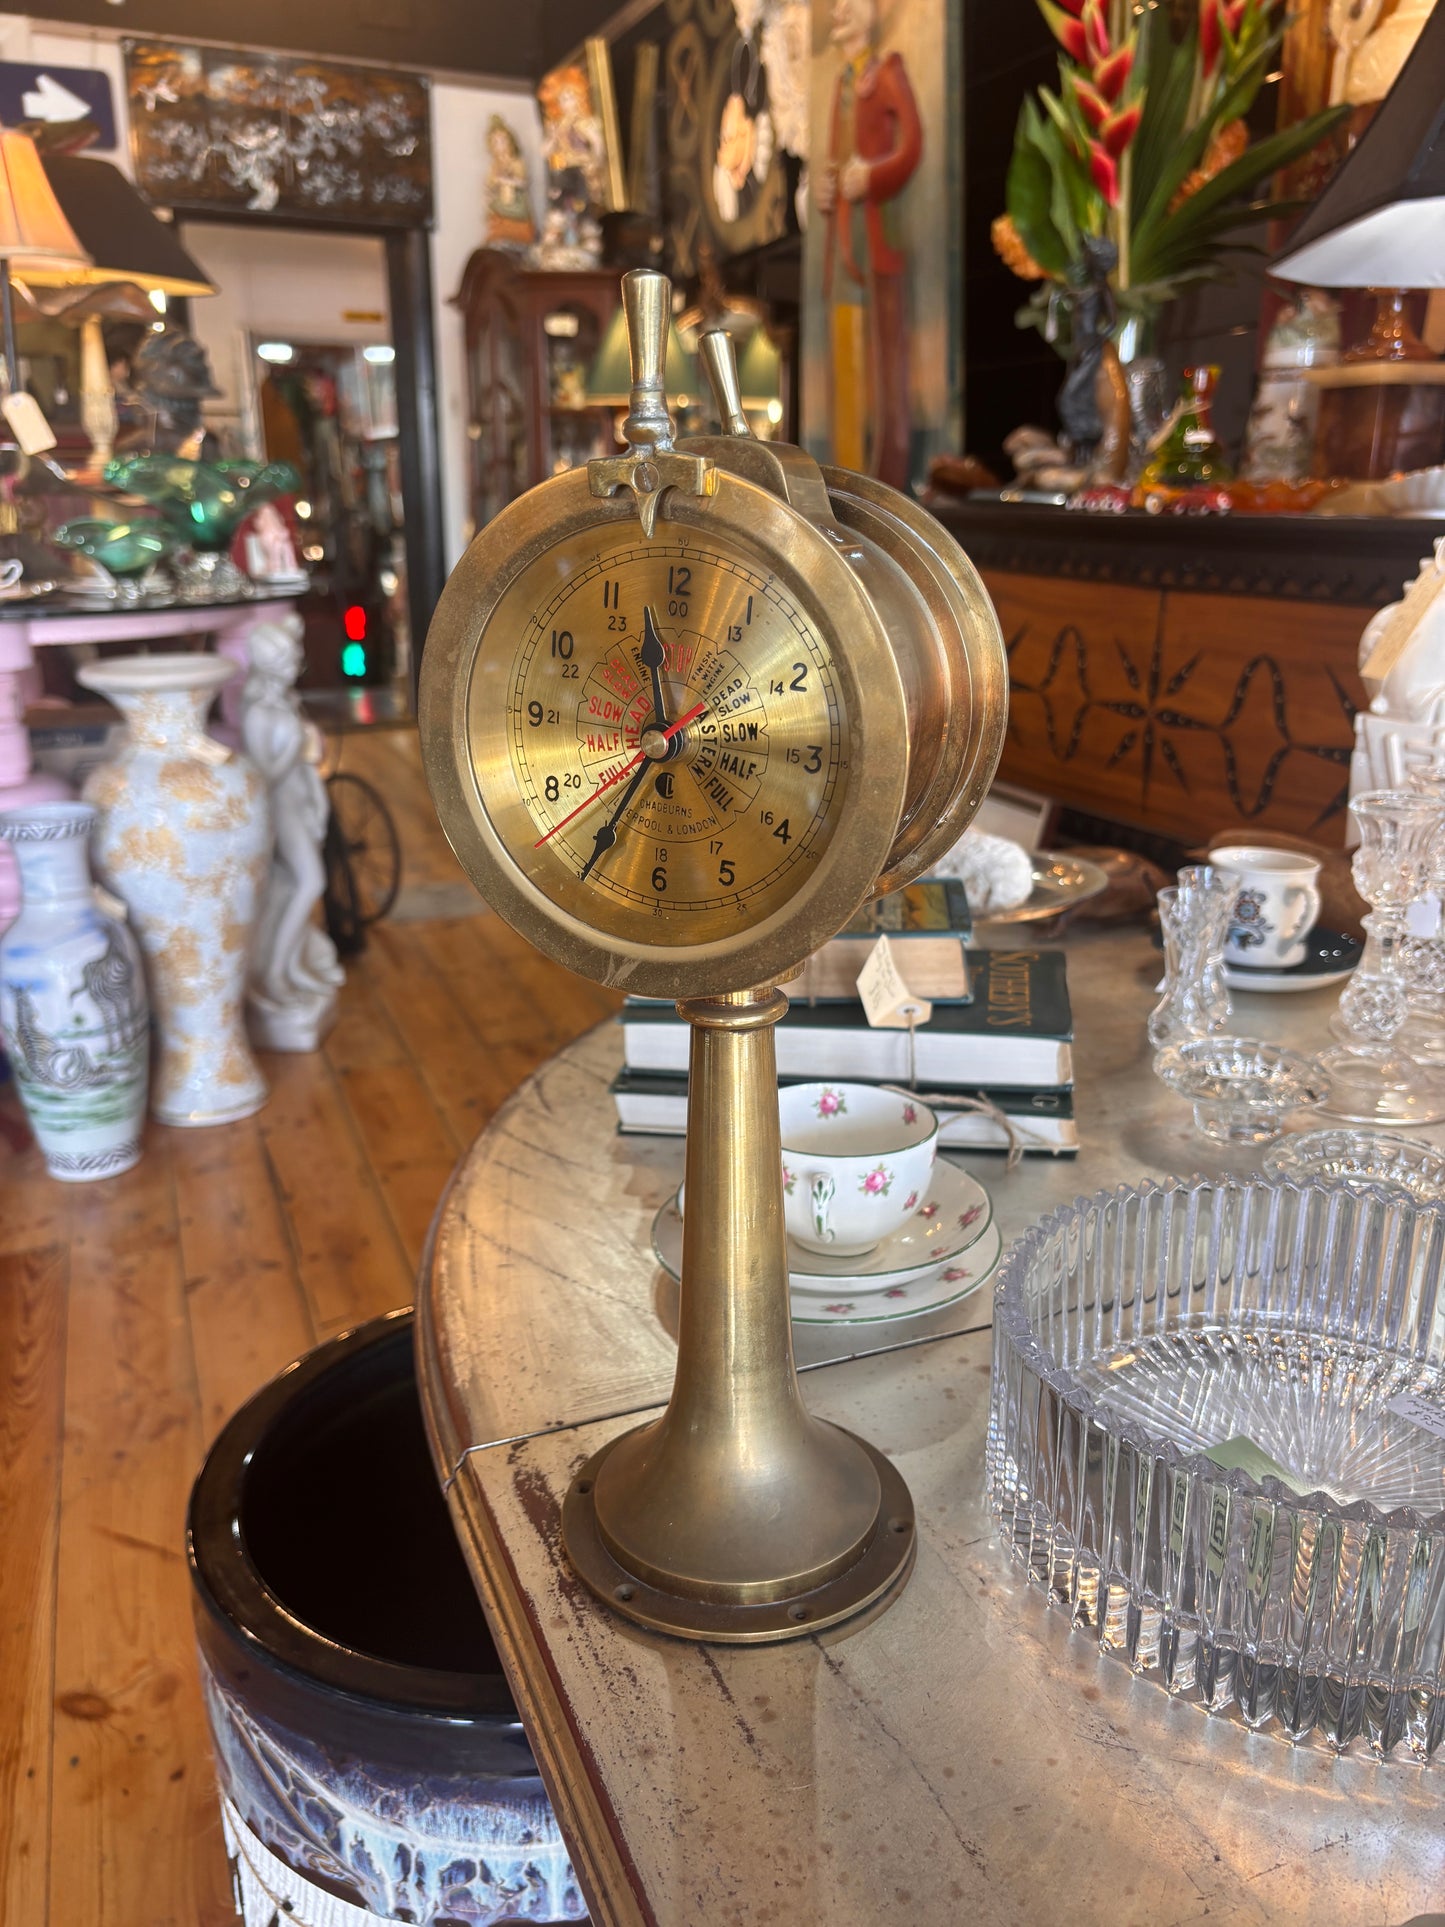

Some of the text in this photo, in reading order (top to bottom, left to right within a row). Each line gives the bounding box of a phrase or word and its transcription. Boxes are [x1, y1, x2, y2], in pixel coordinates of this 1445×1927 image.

[668, 566, 691, 596] 12
[604, 580, 619, 609] 11
[668, 600, 688, 617] 00
[746, 595, 753, 625] 1
[608, 616, 626, 631] 23
[728, 625, 742, 641] 13
[552, 630, 573, 660] 10
[663, 643, 692, 673] STOP
[562, 664, 579, 679] 22
[610, 659, 638, 692] DEAD
[691, 651, 712, 681] FINISH
[701, 658, 718, 681] WITH
[703, 663, 725, 695] ENGINE
[790, 662, 807, 692] 2
[602, 669, 630, 699] SLOW
[712, 678, 742, 706] DEAD
[770, 680, 784, 696] 14
[528, 701, 543, 727] 9
[547, 710, 560, 724] 21
[588, 695, 624, 723] SLOW
[718, 692, 751, 717] SLOW
[586, 732, 619, 753] HALF
[693, 711, 718, 779] ASTERN
[722, 722, 758, 743] SLOW
[720, 752, 757, 780] HALF
[786, 748, 800, 764] 15
[803, 745, 822, 774] 3
[564, 773, 581, 789] 20
[598, 761, 631, 786] FULL
[545, 775, 560, 802] 8
[704, 777, 734, 812] FULL
[613, 796, 662, 833] LERPOOL
[667, 825, 673, 834] &
[677, 816, 717, 835] LONDON
[640, 799, 693, 819] CHADBURNS
[760, 810, 774, 826] 16
[772, 818, 792, 845] 4
[655, 847, 668, 862] 18
[710, 840, 723, 855] 17
[652, 866, 667, 892] 6
[718, 859, 735, 886] 5
[652, 907, 662, 917] 30
